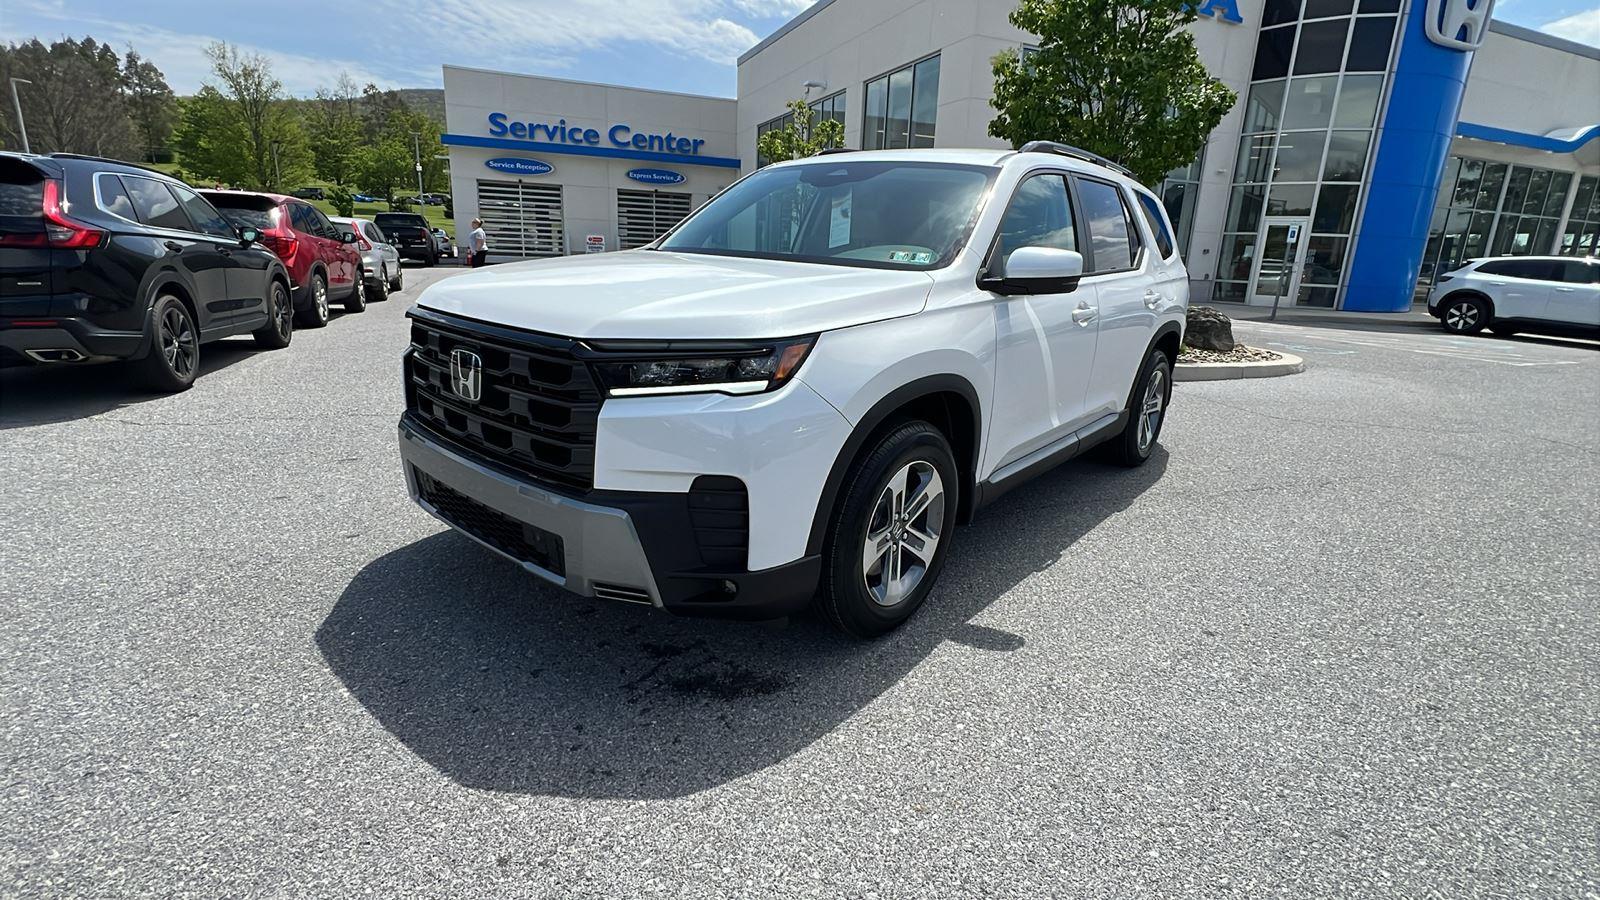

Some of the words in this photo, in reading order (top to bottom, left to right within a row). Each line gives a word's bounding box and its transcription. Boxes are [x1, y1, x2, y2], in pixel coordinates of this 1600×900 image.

[488, 112, 600, 145] Service
[608, 124, 705, 154] Center
[489, 161, 515, 169] Service
[516, 163, 550, 171] Reception
